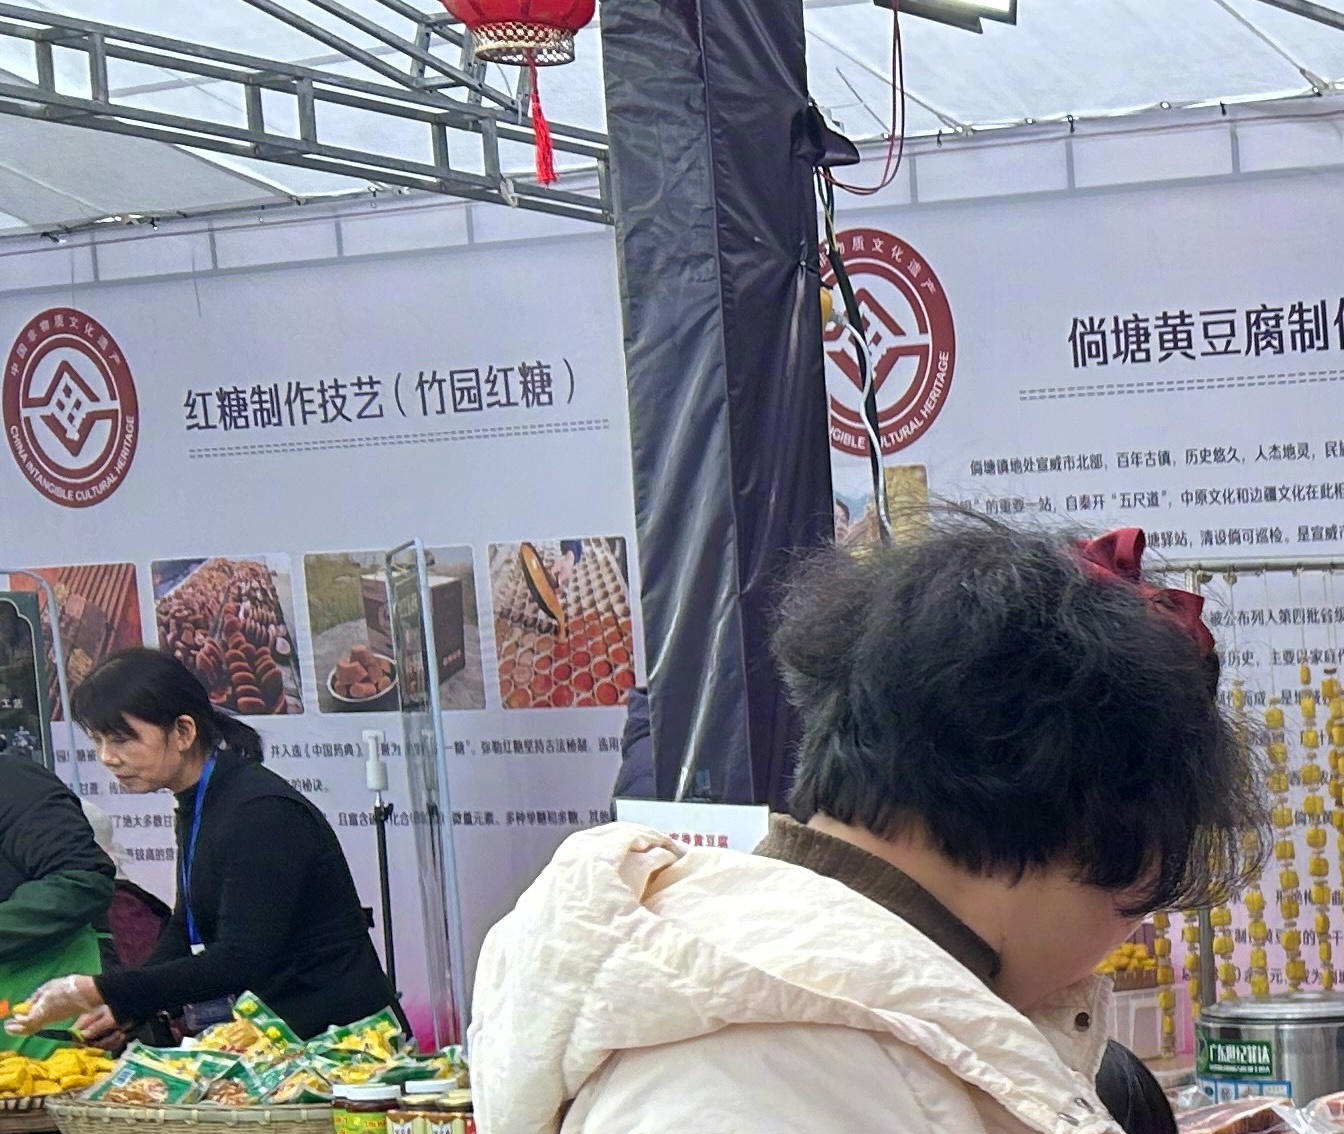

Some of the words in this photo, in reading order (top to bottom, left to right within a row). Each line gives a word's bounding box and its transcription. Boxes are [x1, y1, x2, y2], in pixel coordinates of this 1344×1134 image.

[184, 358, 577, 431] 红糖制作技艺（竹园红糖）
[920, 350, 949, 419] HERITAGE
[10, 425, 27, 463] CHINA
[75, 473, 118, 501] CULTURAL
[115, 415, 135, 475] HERITAGE
